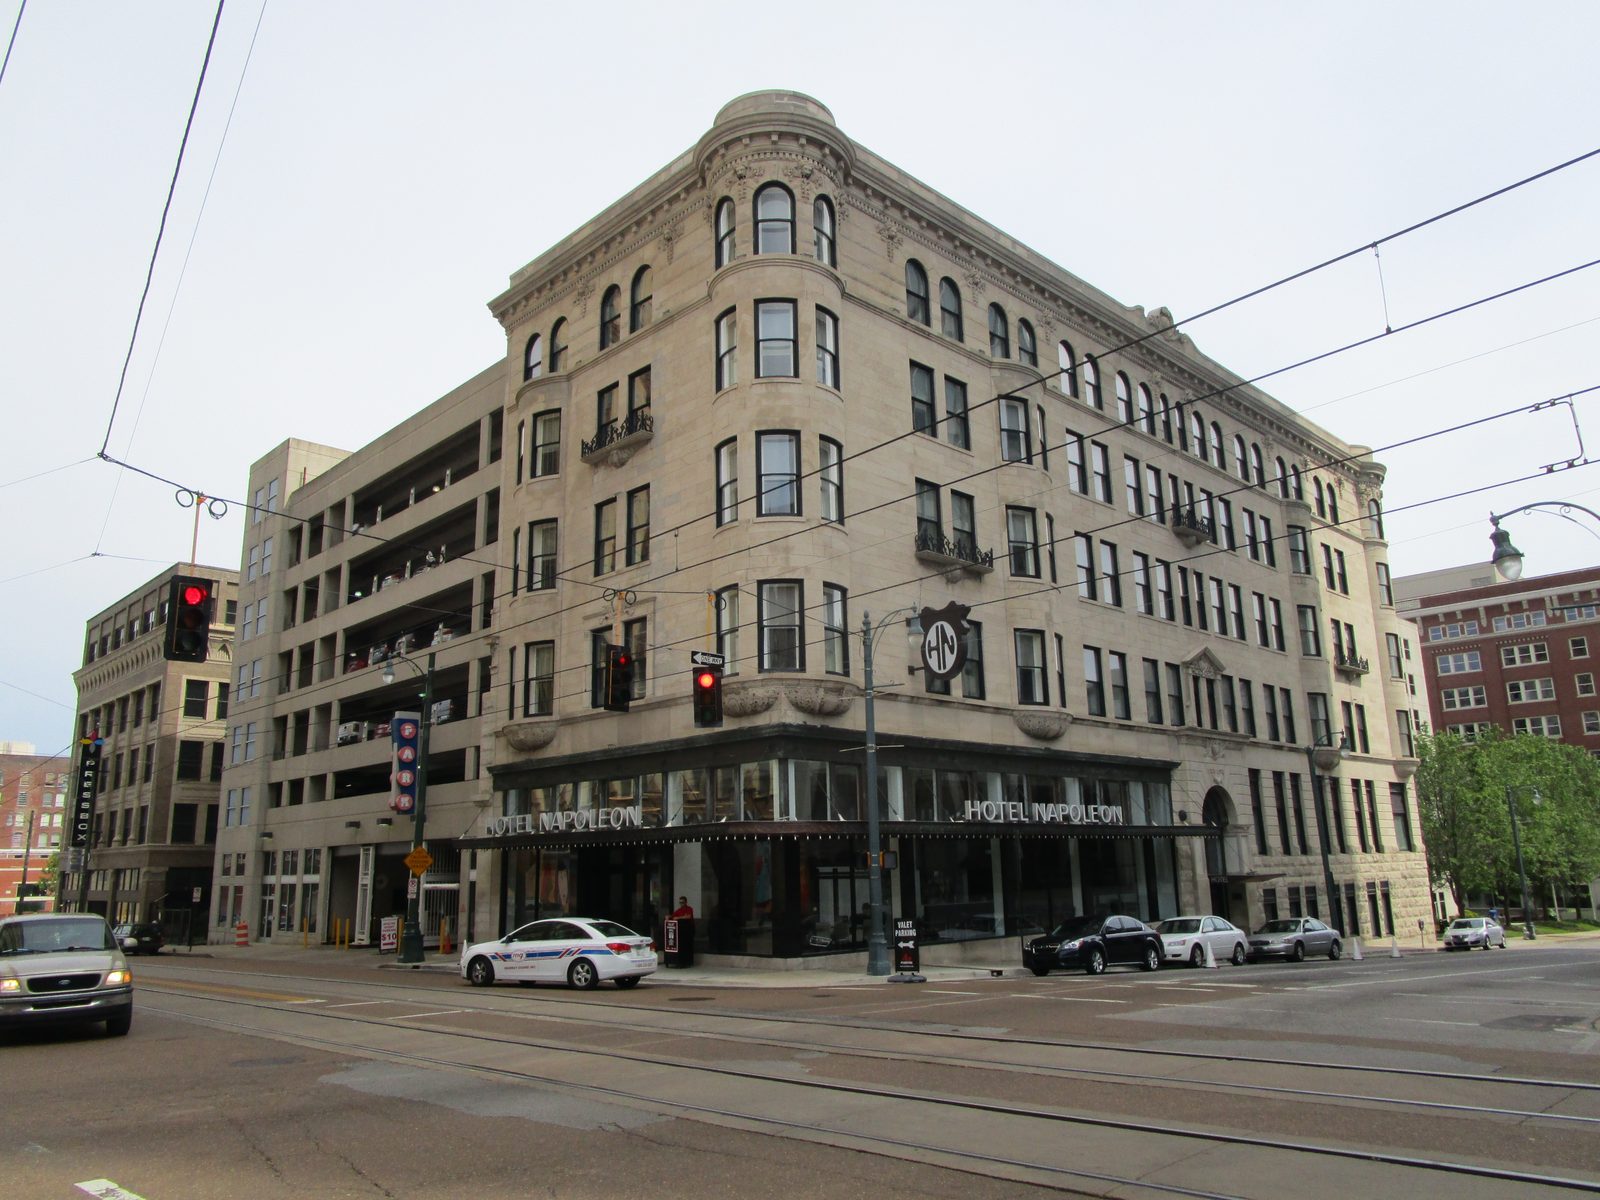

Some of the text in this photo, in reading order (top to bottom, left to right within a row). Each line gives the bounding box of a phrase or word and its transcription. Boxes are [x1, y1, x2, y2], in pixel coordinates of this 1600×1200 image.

[399, 724, 414, 808] PARK
[77, 760, 96, 841] PRESSBOX
[965, 800, 1123, 823] HOTEL NAPOLEON
[485, 806, 641, 835] HOTEL NAPOLEON
[381, 932, 397, 941] $10
[895, 929, 917, 937] PARKING
[897, 921, 913, 929] VALET
